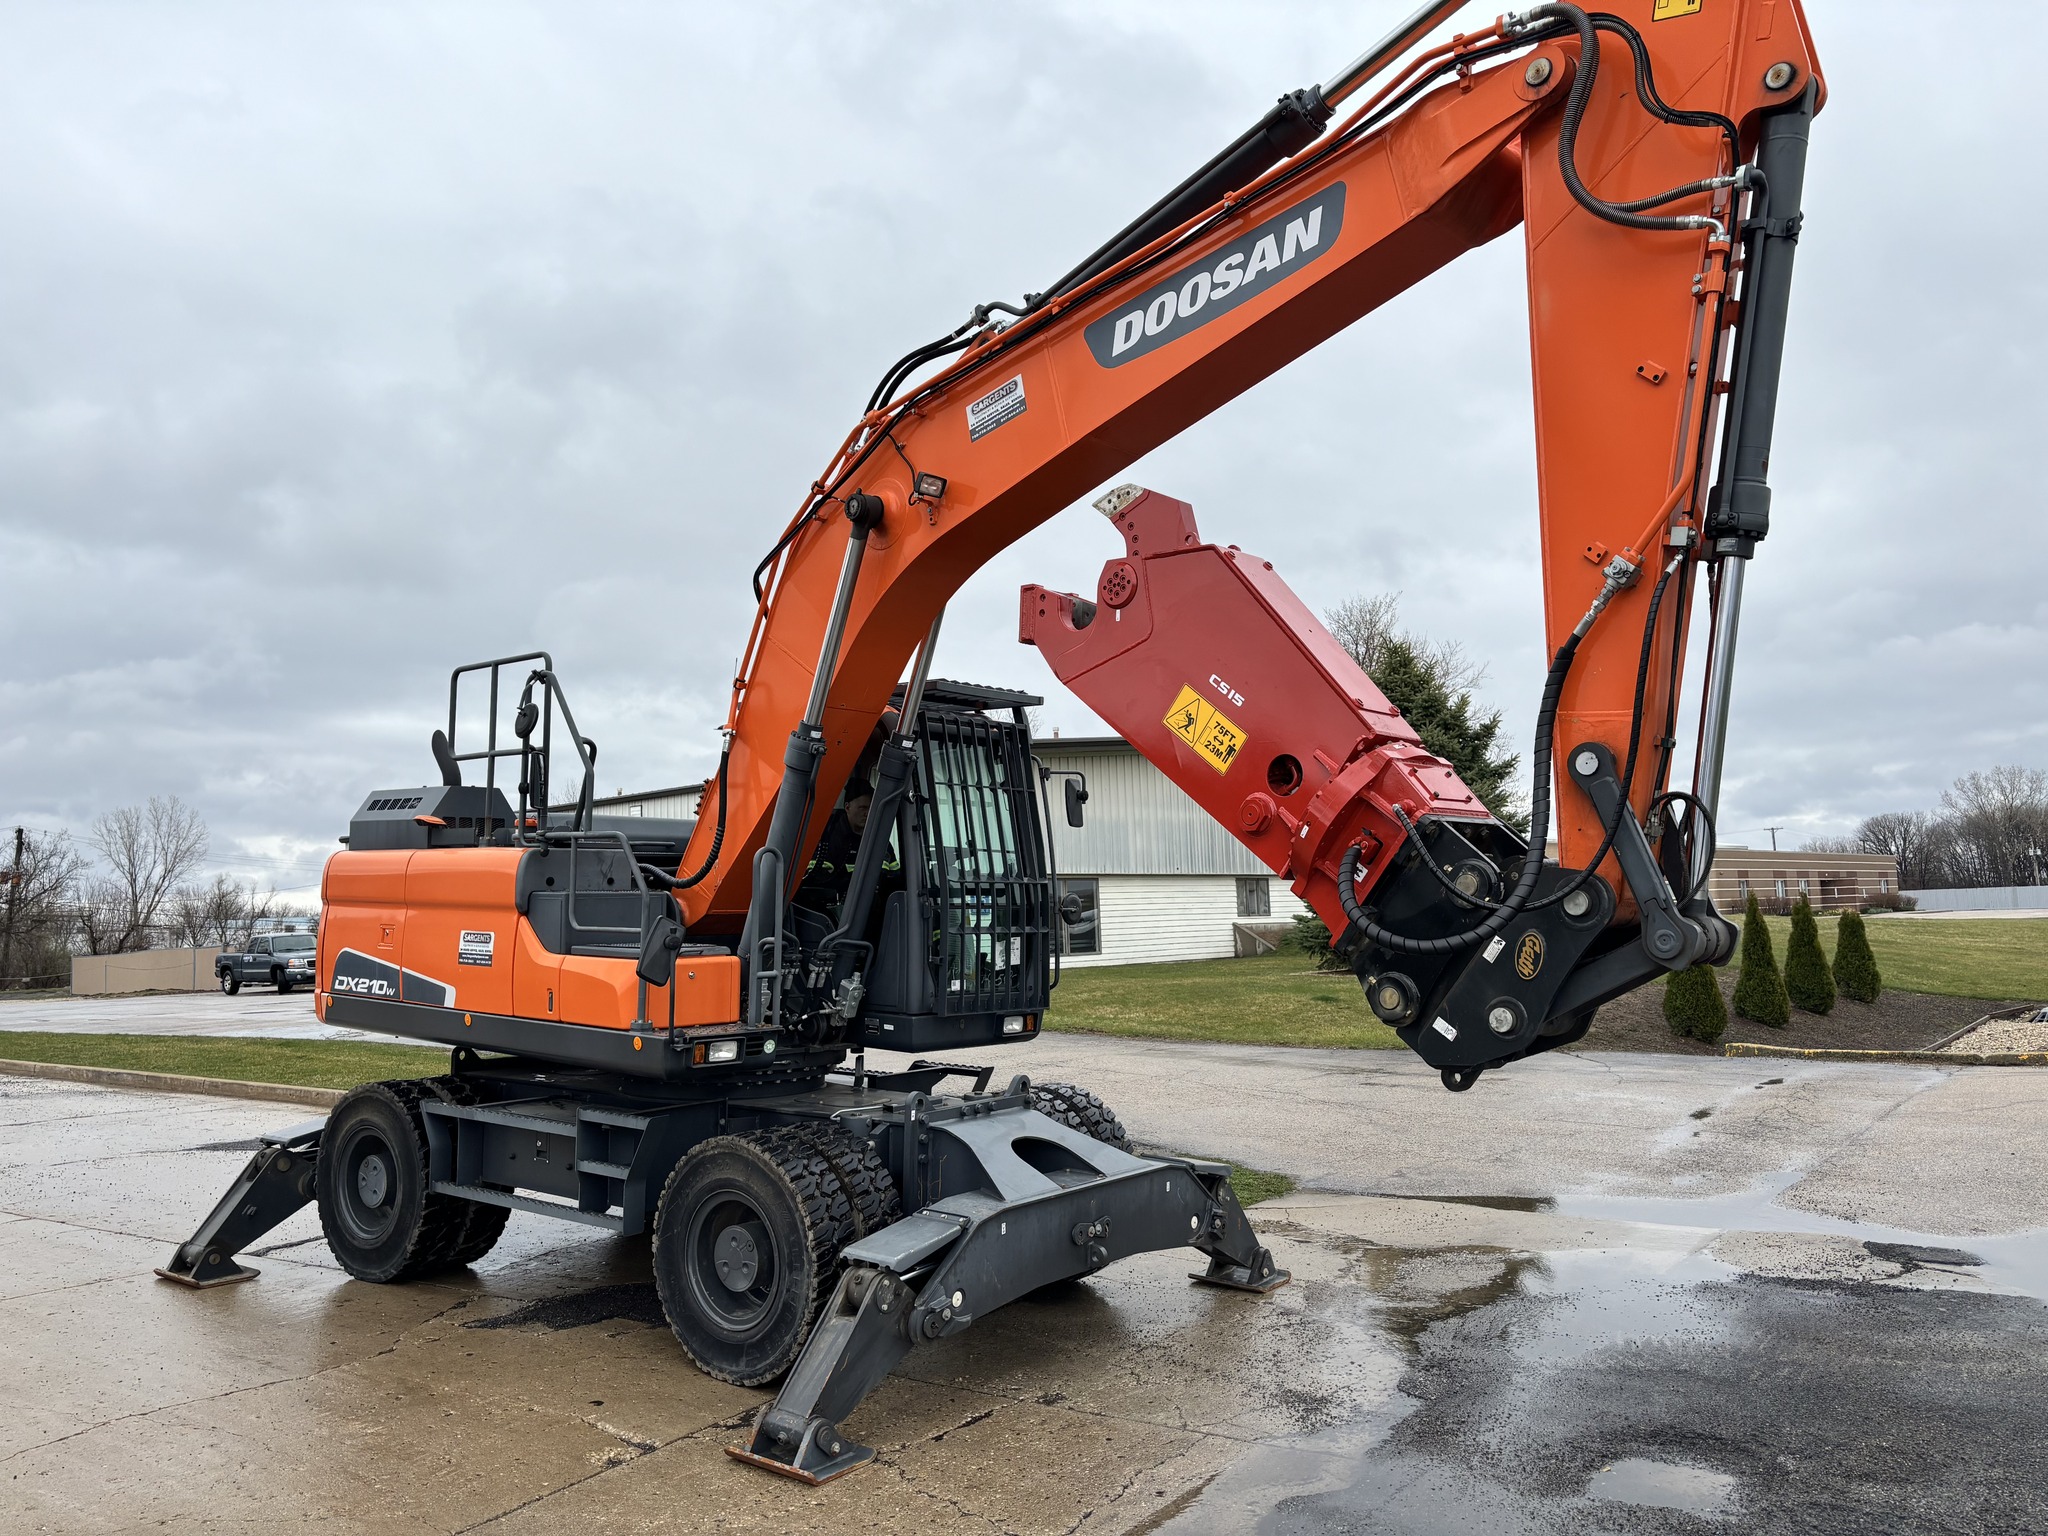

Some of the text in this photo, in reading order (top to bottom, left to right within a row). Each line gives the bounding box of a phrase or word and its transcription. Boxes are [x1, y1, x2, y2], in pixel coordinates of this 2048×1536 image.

[1112, 205, 1323, 358] DOOSAN
[972, 381, 1017, 414] SARGENTS
[1208, 673, 1245, 707] CS15
[1204, 740, 1224, 760] 23M
[464, 933, 491, 943] SARGENTS
